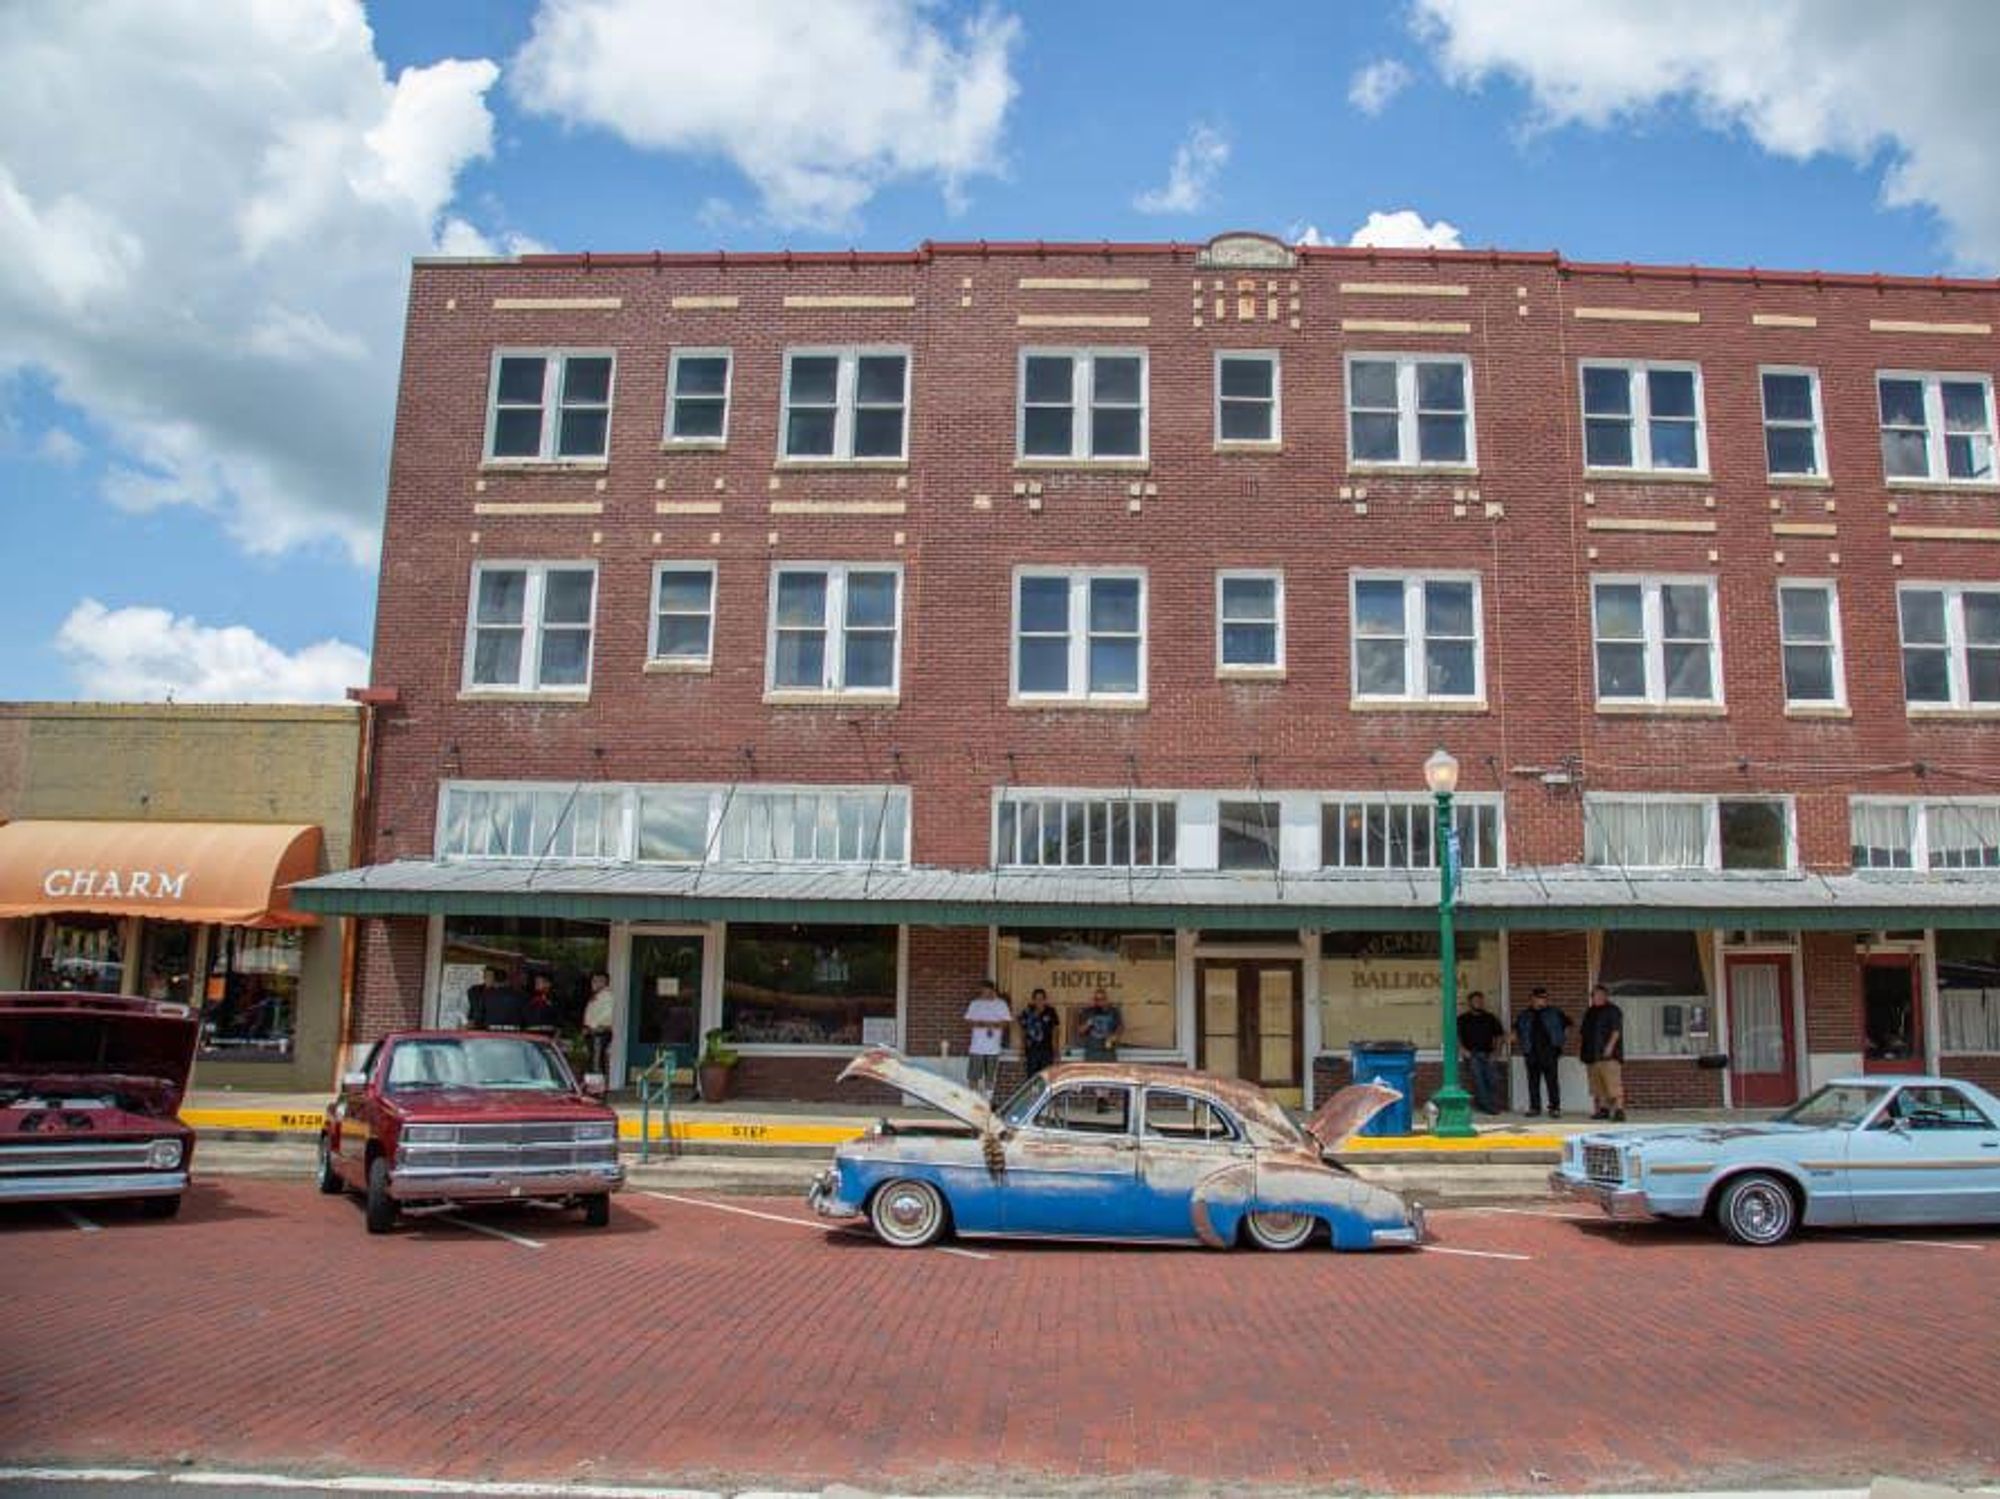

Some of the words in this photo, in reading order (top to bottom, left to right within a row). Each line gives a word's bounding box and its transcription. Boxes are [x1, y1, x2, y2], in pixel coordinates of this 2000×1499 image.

[43, 869, 189, 899] CHARM
[1051, 970, 1123, 989] HOTEL
[281, 1113, 323, 1126] WATCH
[731, 1125, 769, 1138] STEP
